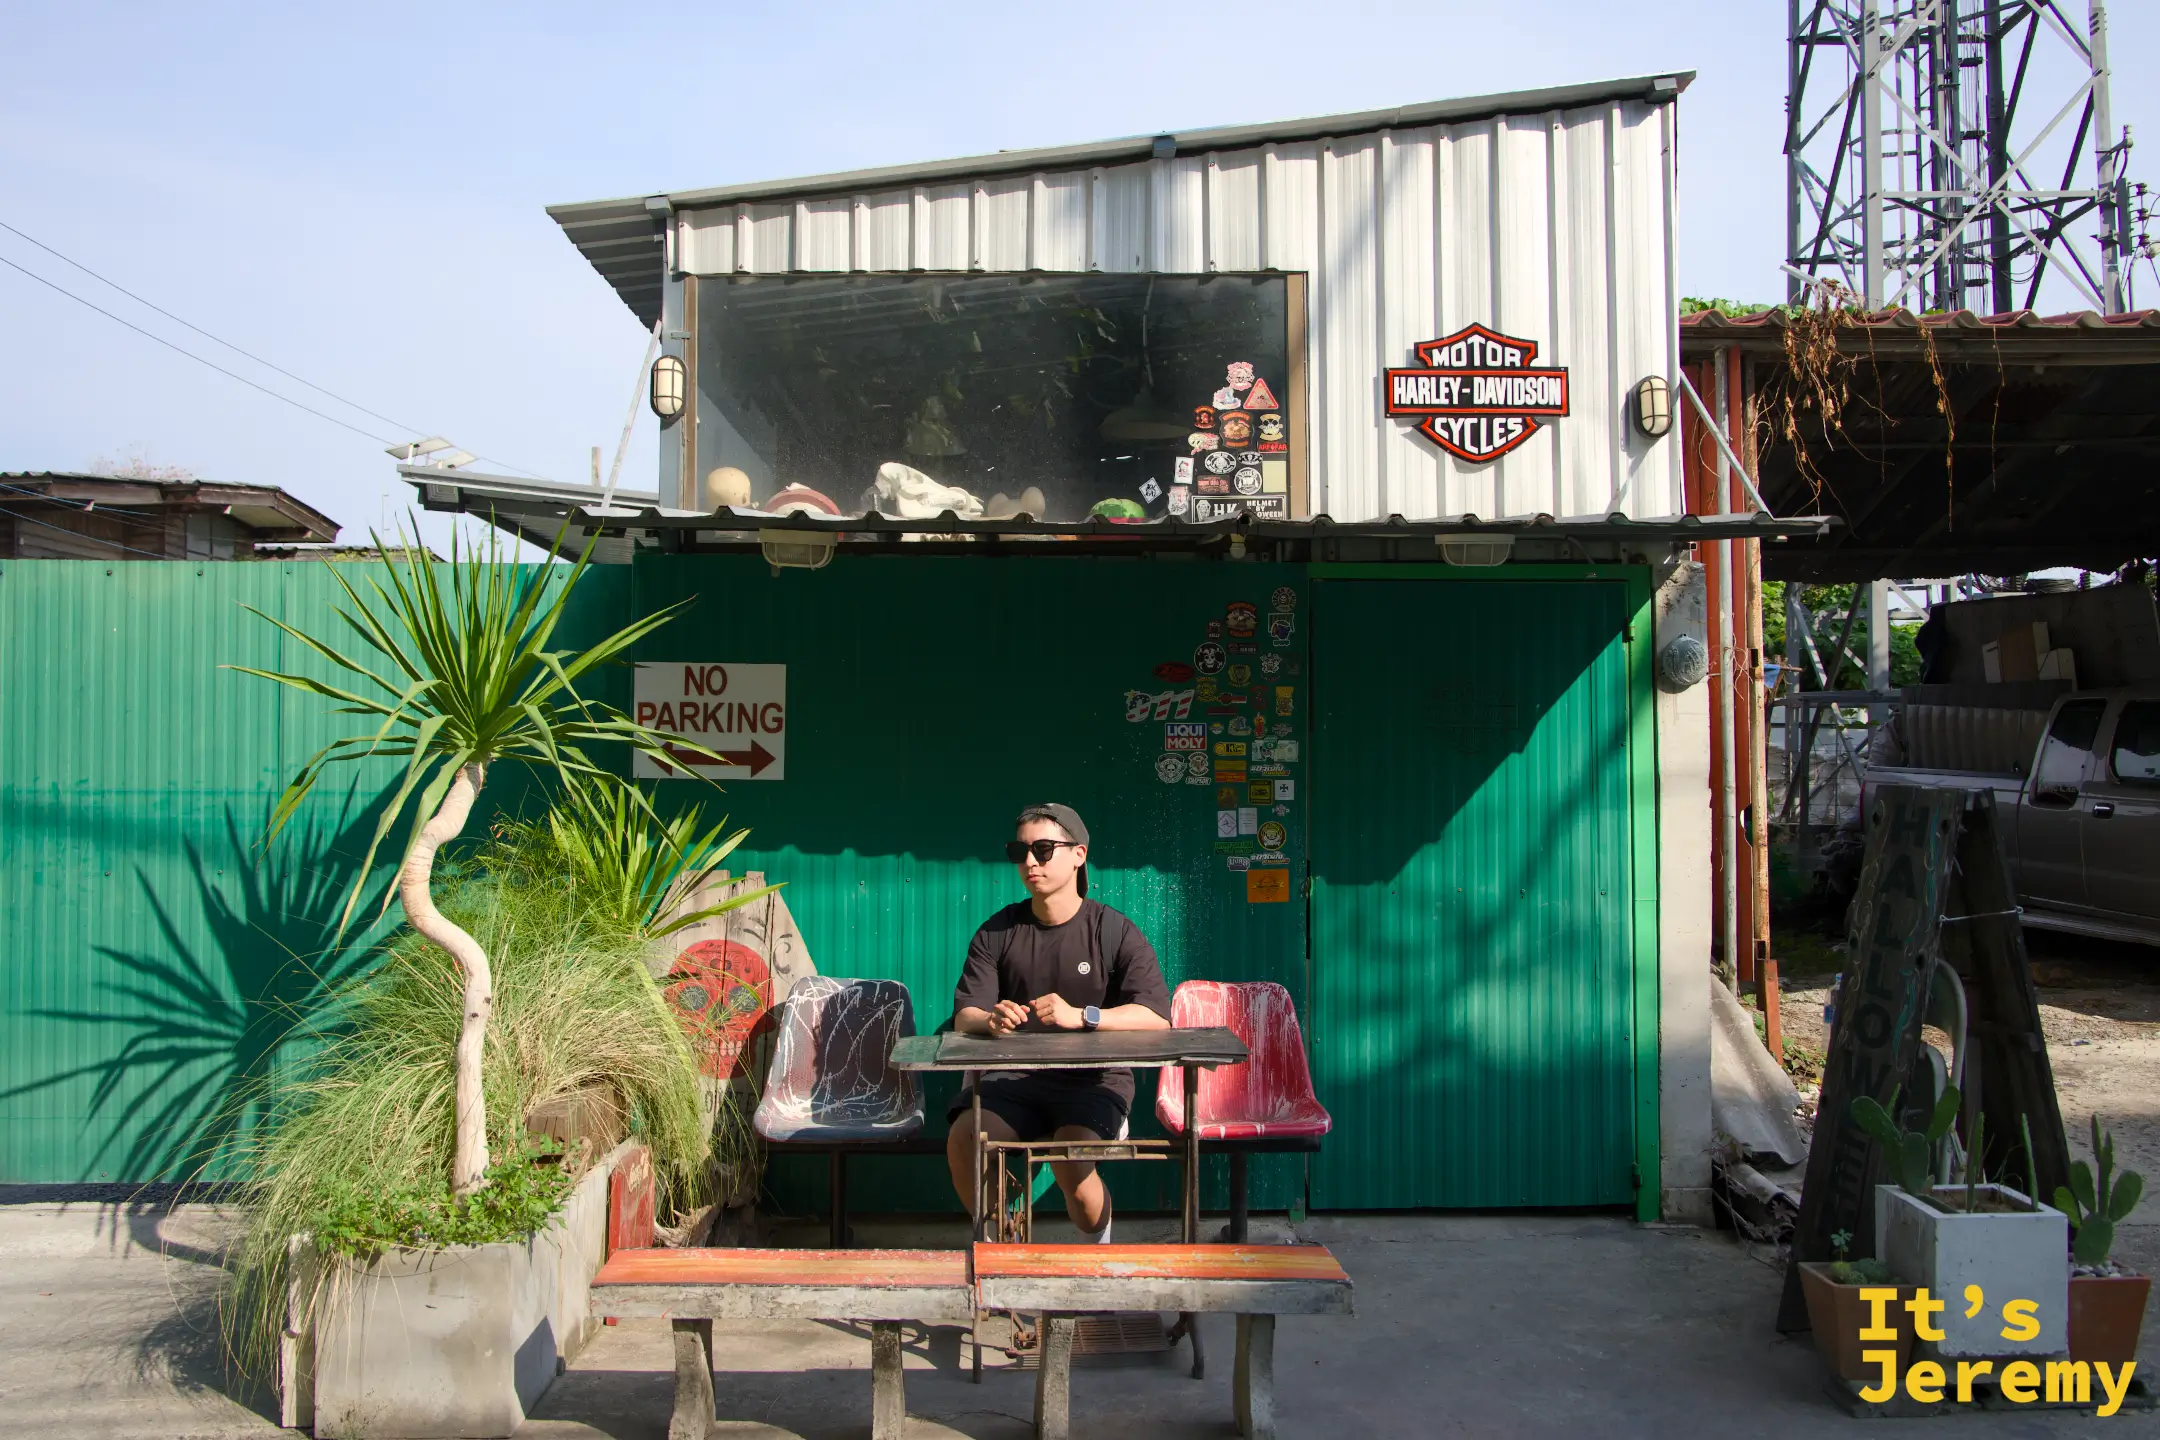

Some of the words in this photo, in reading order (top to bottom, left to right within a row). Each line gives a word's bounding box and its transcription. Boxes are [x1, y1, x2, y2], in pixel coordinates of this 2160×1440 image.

[1432, 334, 1522, 367] MOTOR
[1393, 376, 1562, 406] HARLEY-DAVIDSON
[1435, 417, 1524, 455] CYCLES
[684, 665, 728, 696] NO
[637, 702, 784, 734] PARKING
[1167, 725, 1203, 737] LIQUI
[1167, 737, 1204, 749] MOLY
